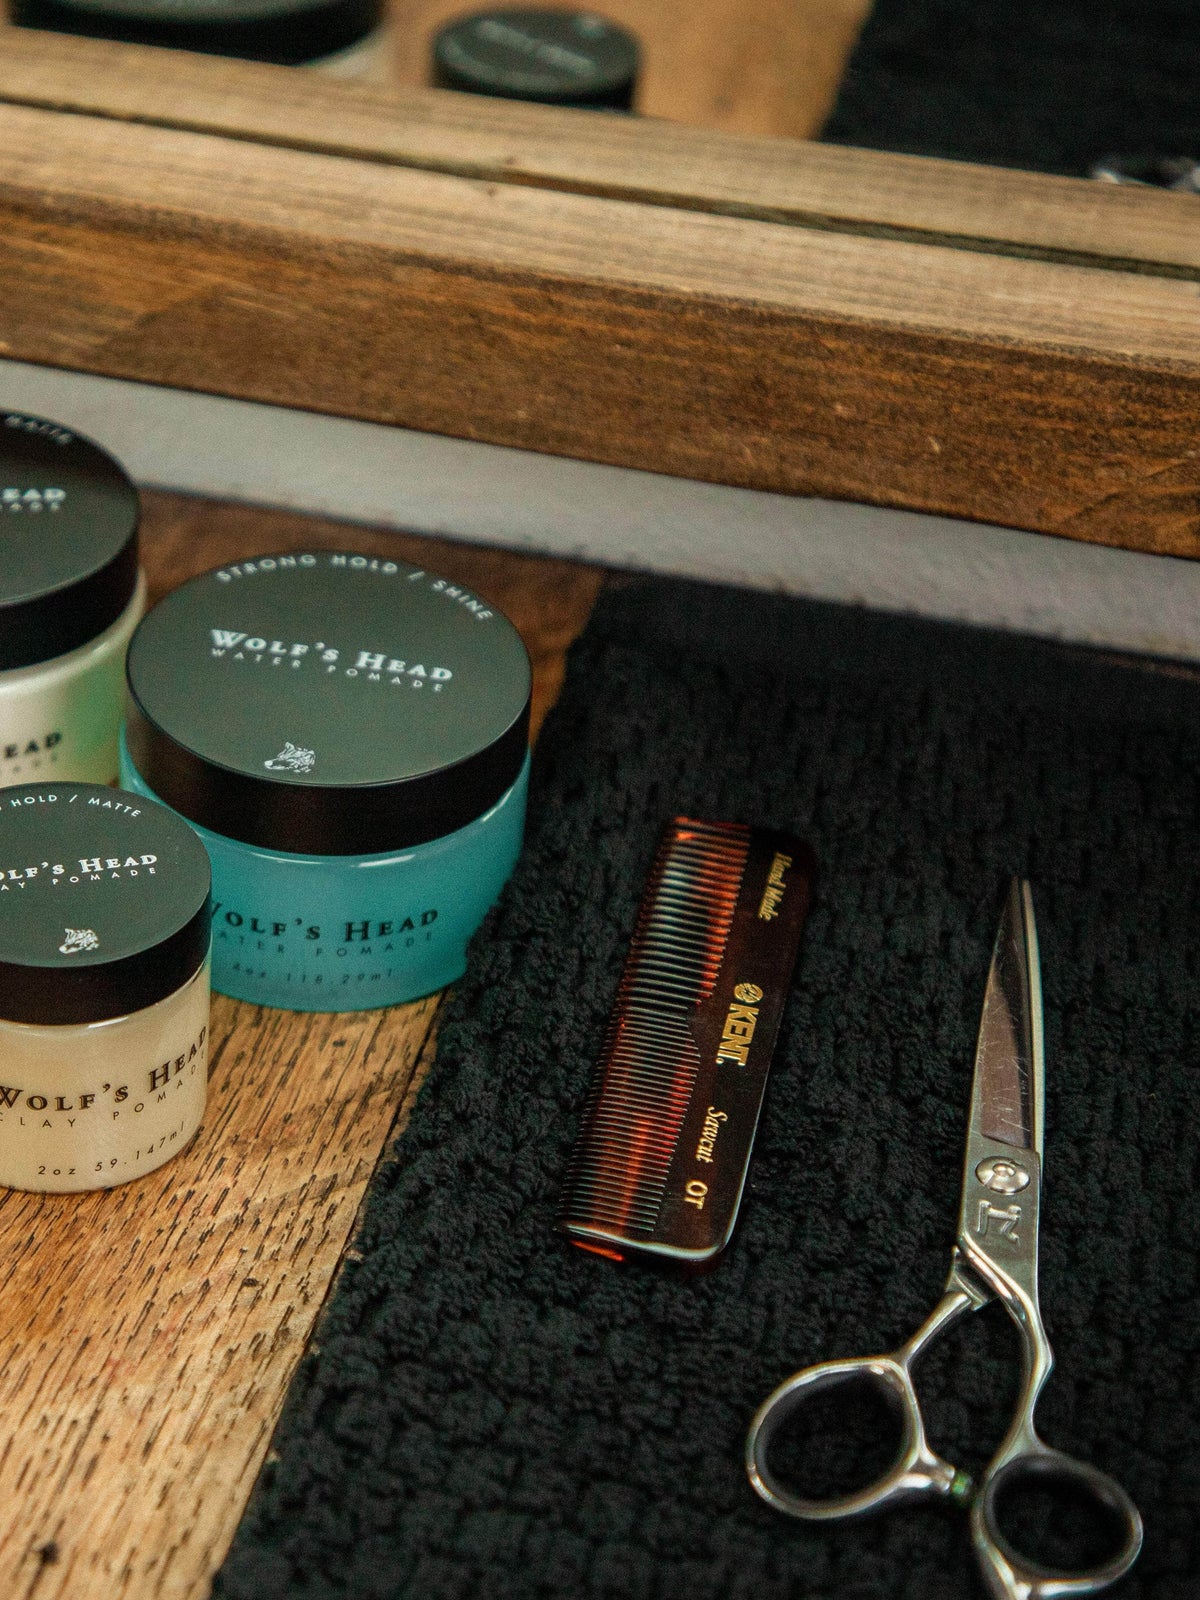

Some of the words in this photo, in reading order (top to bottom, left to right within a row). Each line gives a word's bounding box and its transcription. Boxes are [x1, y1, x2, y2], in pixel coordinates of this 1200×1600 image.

[216, 554, 317, 583] STRONG
[330, 554, 399, 575] HOLD
[432, 579, 493, 621] SHINE
[210, 628, 340, 662] WOLF'S
[354, 650, 453, 682] HEAD
[211, 647, 301, 669] WATER
[327, 664, 444, 692] POMADE
[9, 794, 58, 808] HOLD
[88, 795, 143, 818] MATTE
[52, 867, 156, 886] POMADE
[77, 854, 158, 874] HEAD
[211, 902, 321, 941] OLF'S
[343, 909, 439, 942] HEAD
[218, 931, 285, 954] ATER
[315, 931, 433, 958] POMADE
[696, 1105, 729, 1164] Sawcut
[37, 1165, 77, 1176] 2oz
